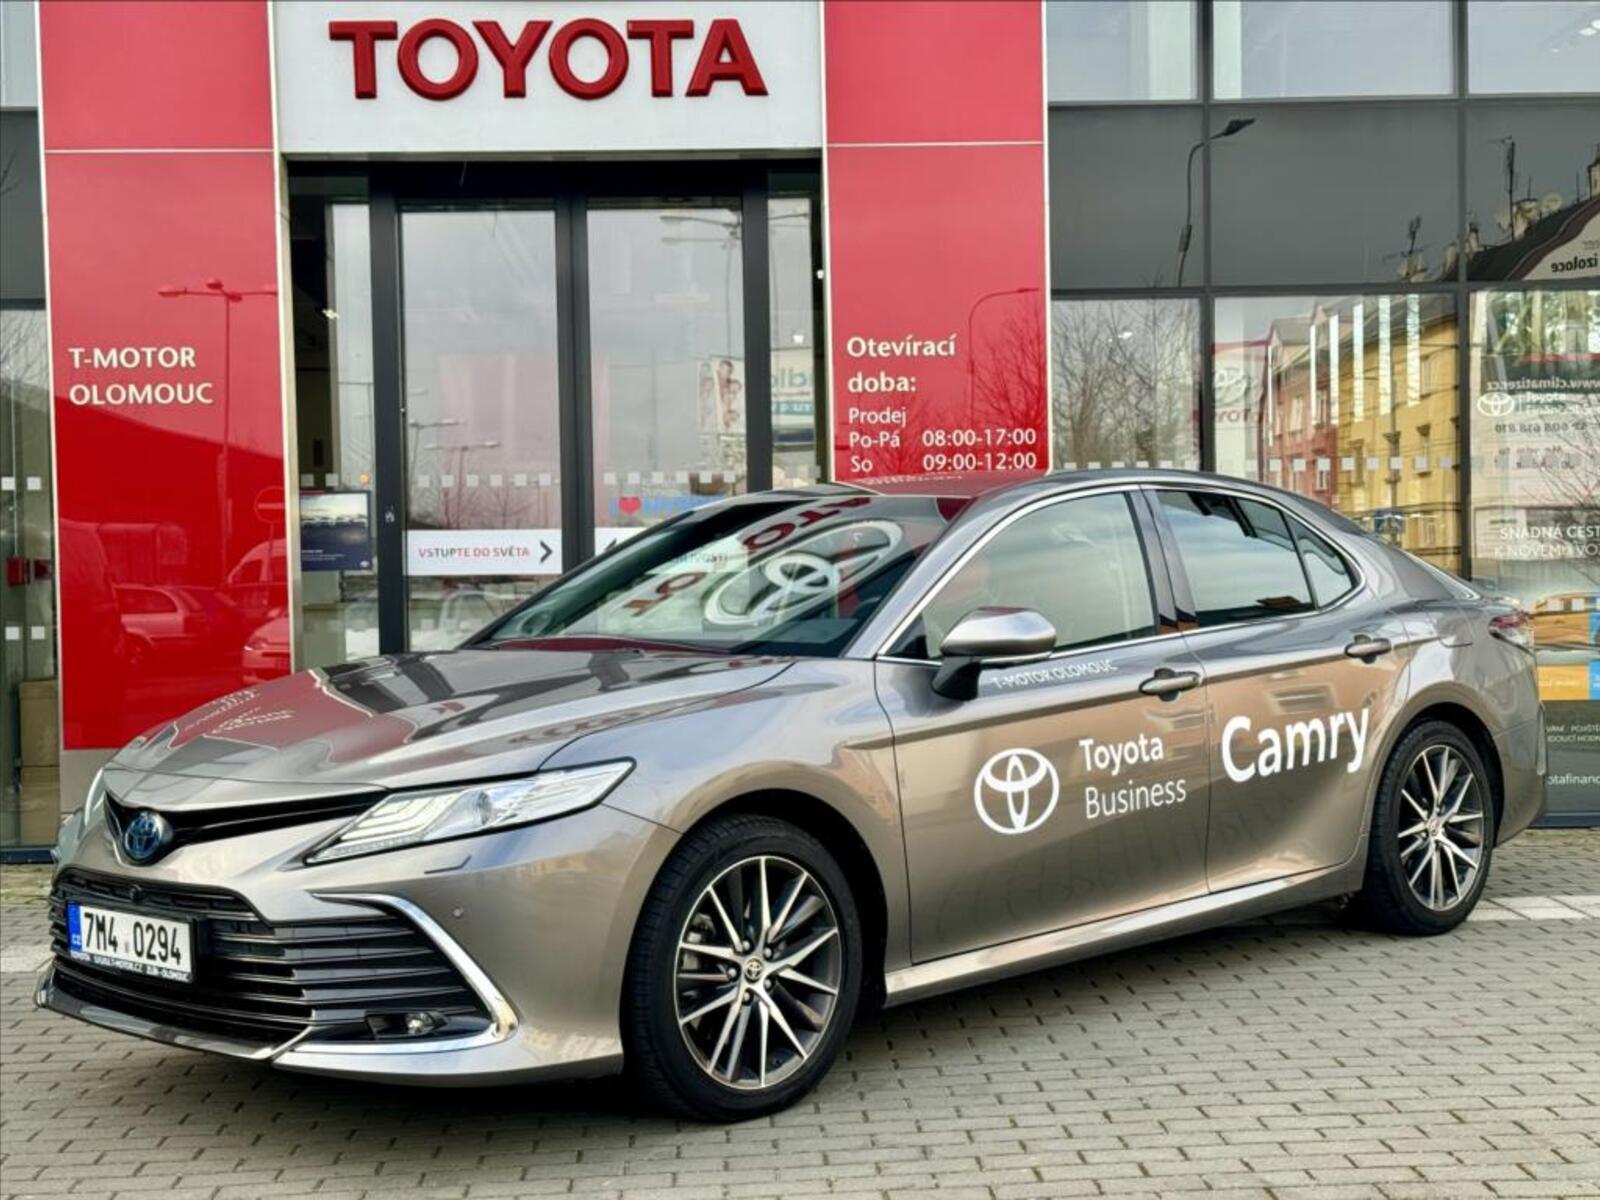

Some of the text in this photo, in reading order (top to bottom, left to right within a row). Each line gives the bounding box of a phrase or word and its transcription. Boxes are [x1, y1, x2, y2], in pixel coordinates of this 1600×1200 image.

[329, 18, 769, 100] TOYOTA
[846, 333, 958, 358] Otevírací
[68, 346, 196, 369] T-MOTOR
[69, 382, 213, 405] OLOMOUC
[848, 371, 917, 393] doba:
[849, 406, 907, 427] Prodej
[849, 428, 1036, 449] Po-Pá 08:00-17:00
[851, 452, 1037, 472] So 09:00-12:00
[419, 546, 530, 558] VSTUPTE DO SVĚTA
[991, 669, 1053, 689] T-MOTOR
[1079, 733, 1164, 776] Toyota
[1221, 708, 1369, 783] Camry
[1085, 778, 1186, 819] Business
[84, 912, 181, 966] 7M4 0294
